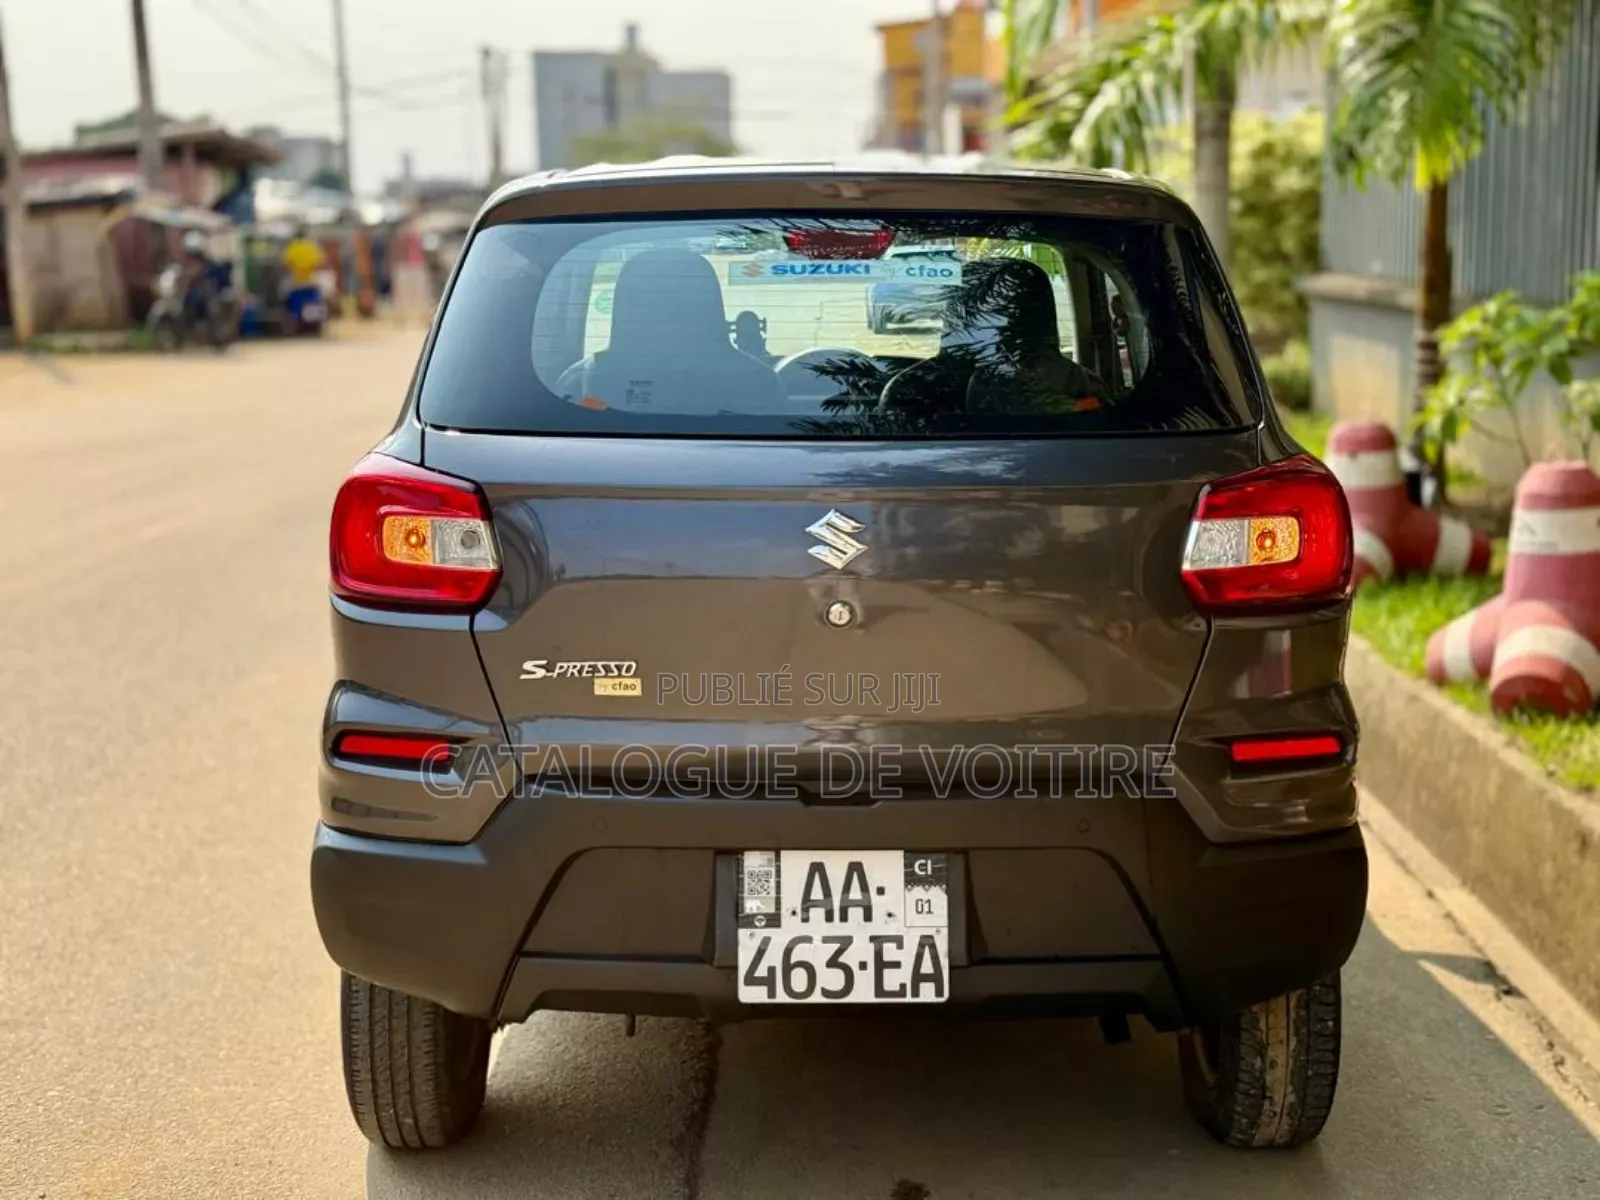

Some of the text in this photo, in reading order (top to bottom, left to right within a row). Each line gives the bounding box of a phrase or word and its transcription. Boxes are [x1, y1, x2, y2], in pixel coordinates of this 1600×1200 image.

[771, 264, 870, 275] SUZUKI
[905, 264, 954, 278] cfao
[519, 660, 637, 679] S-PRESSO
[611, 681, 637, 692] cfao
[914, 859, 933, 875] CI
[915, 898, 934, 915] 01
